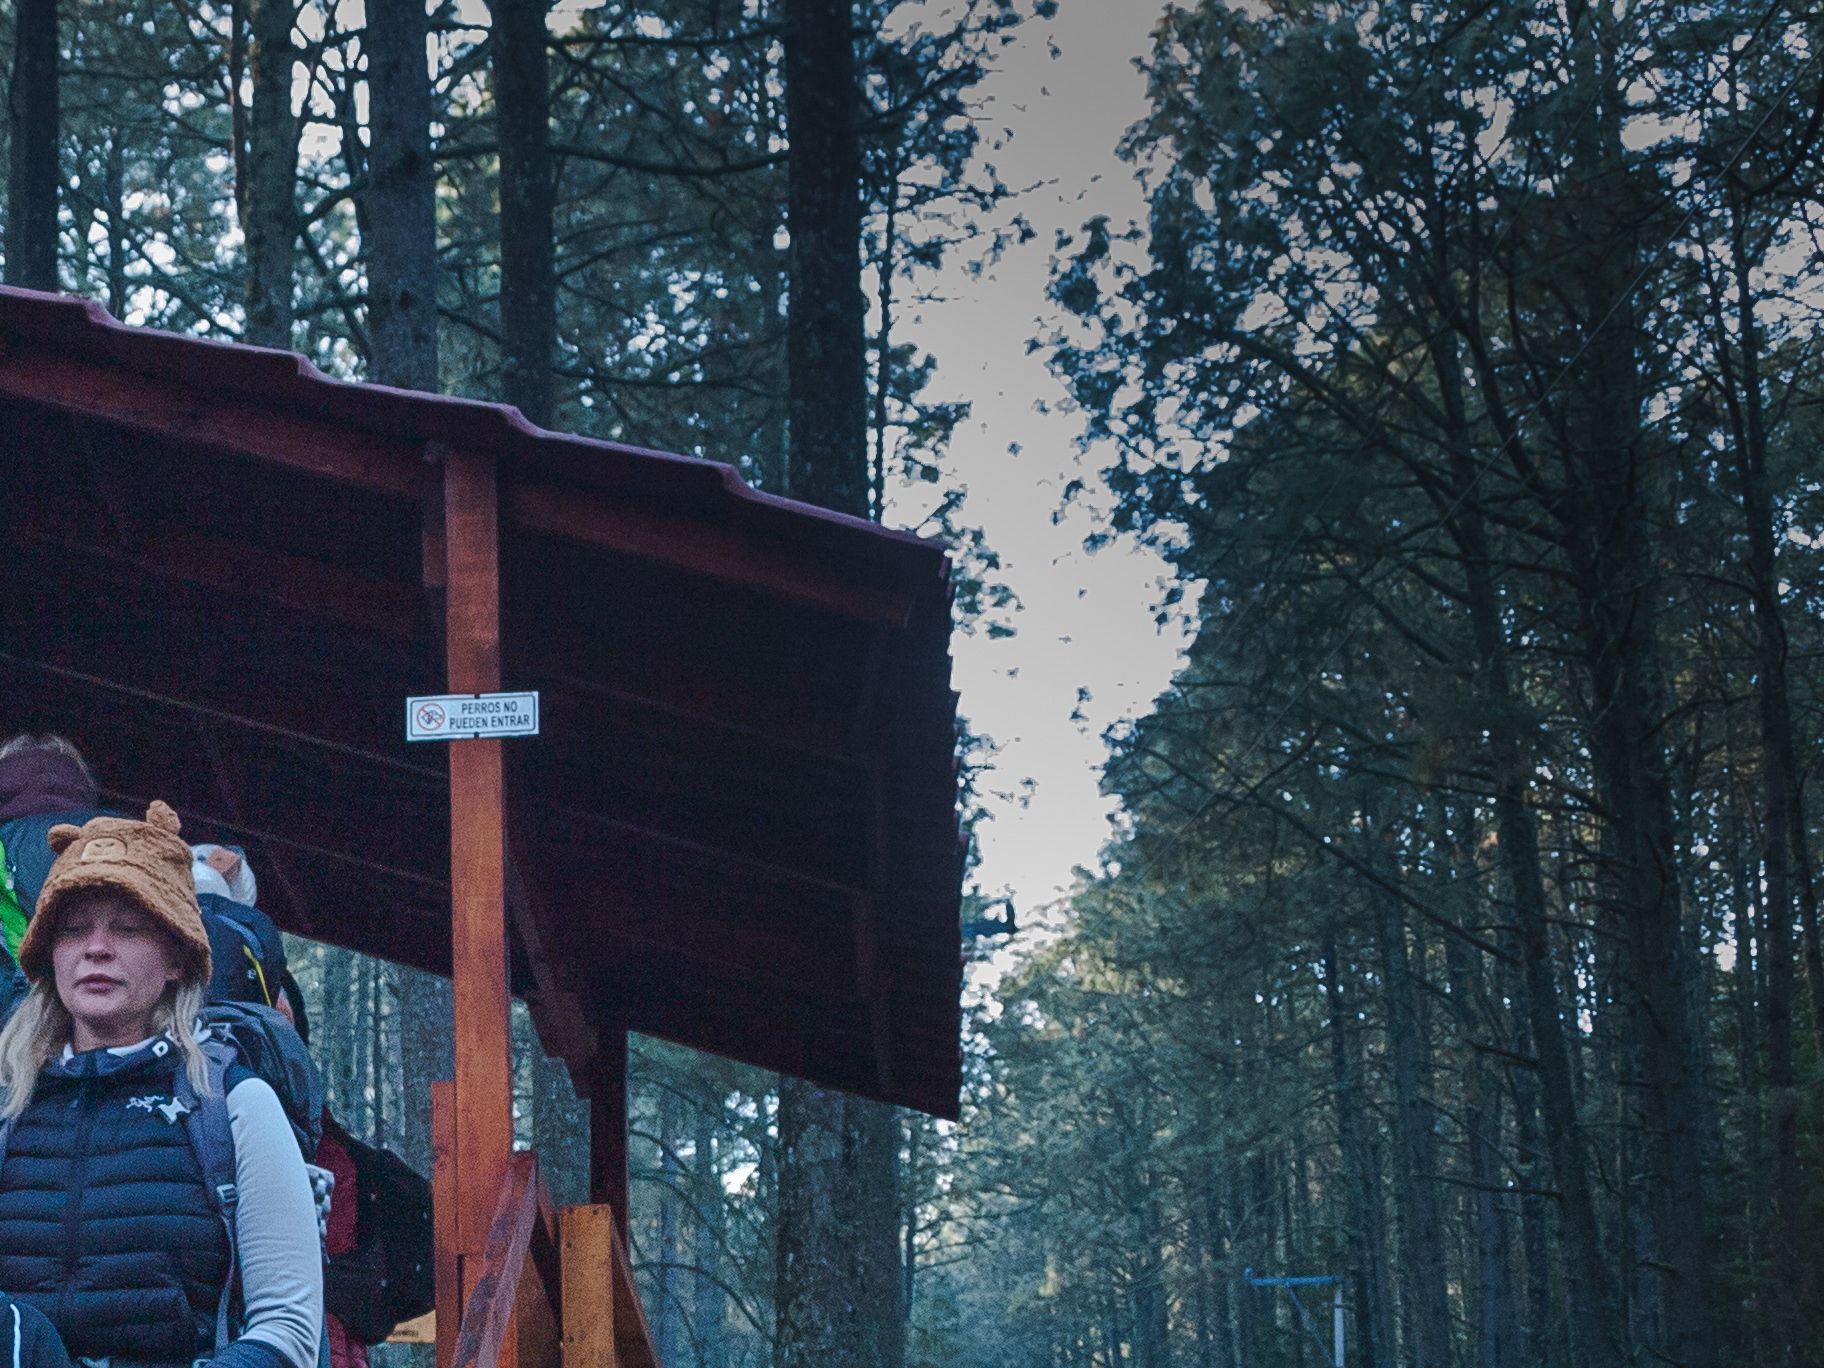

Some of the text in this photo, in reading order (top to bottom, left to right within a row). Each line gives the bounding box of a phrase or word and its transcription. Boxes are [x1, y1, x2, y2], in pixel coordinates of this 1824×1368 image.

[461, 701, 517, 714] PERROS NO
[449, 714, 530, 729] PUEDEN ENTRAR
